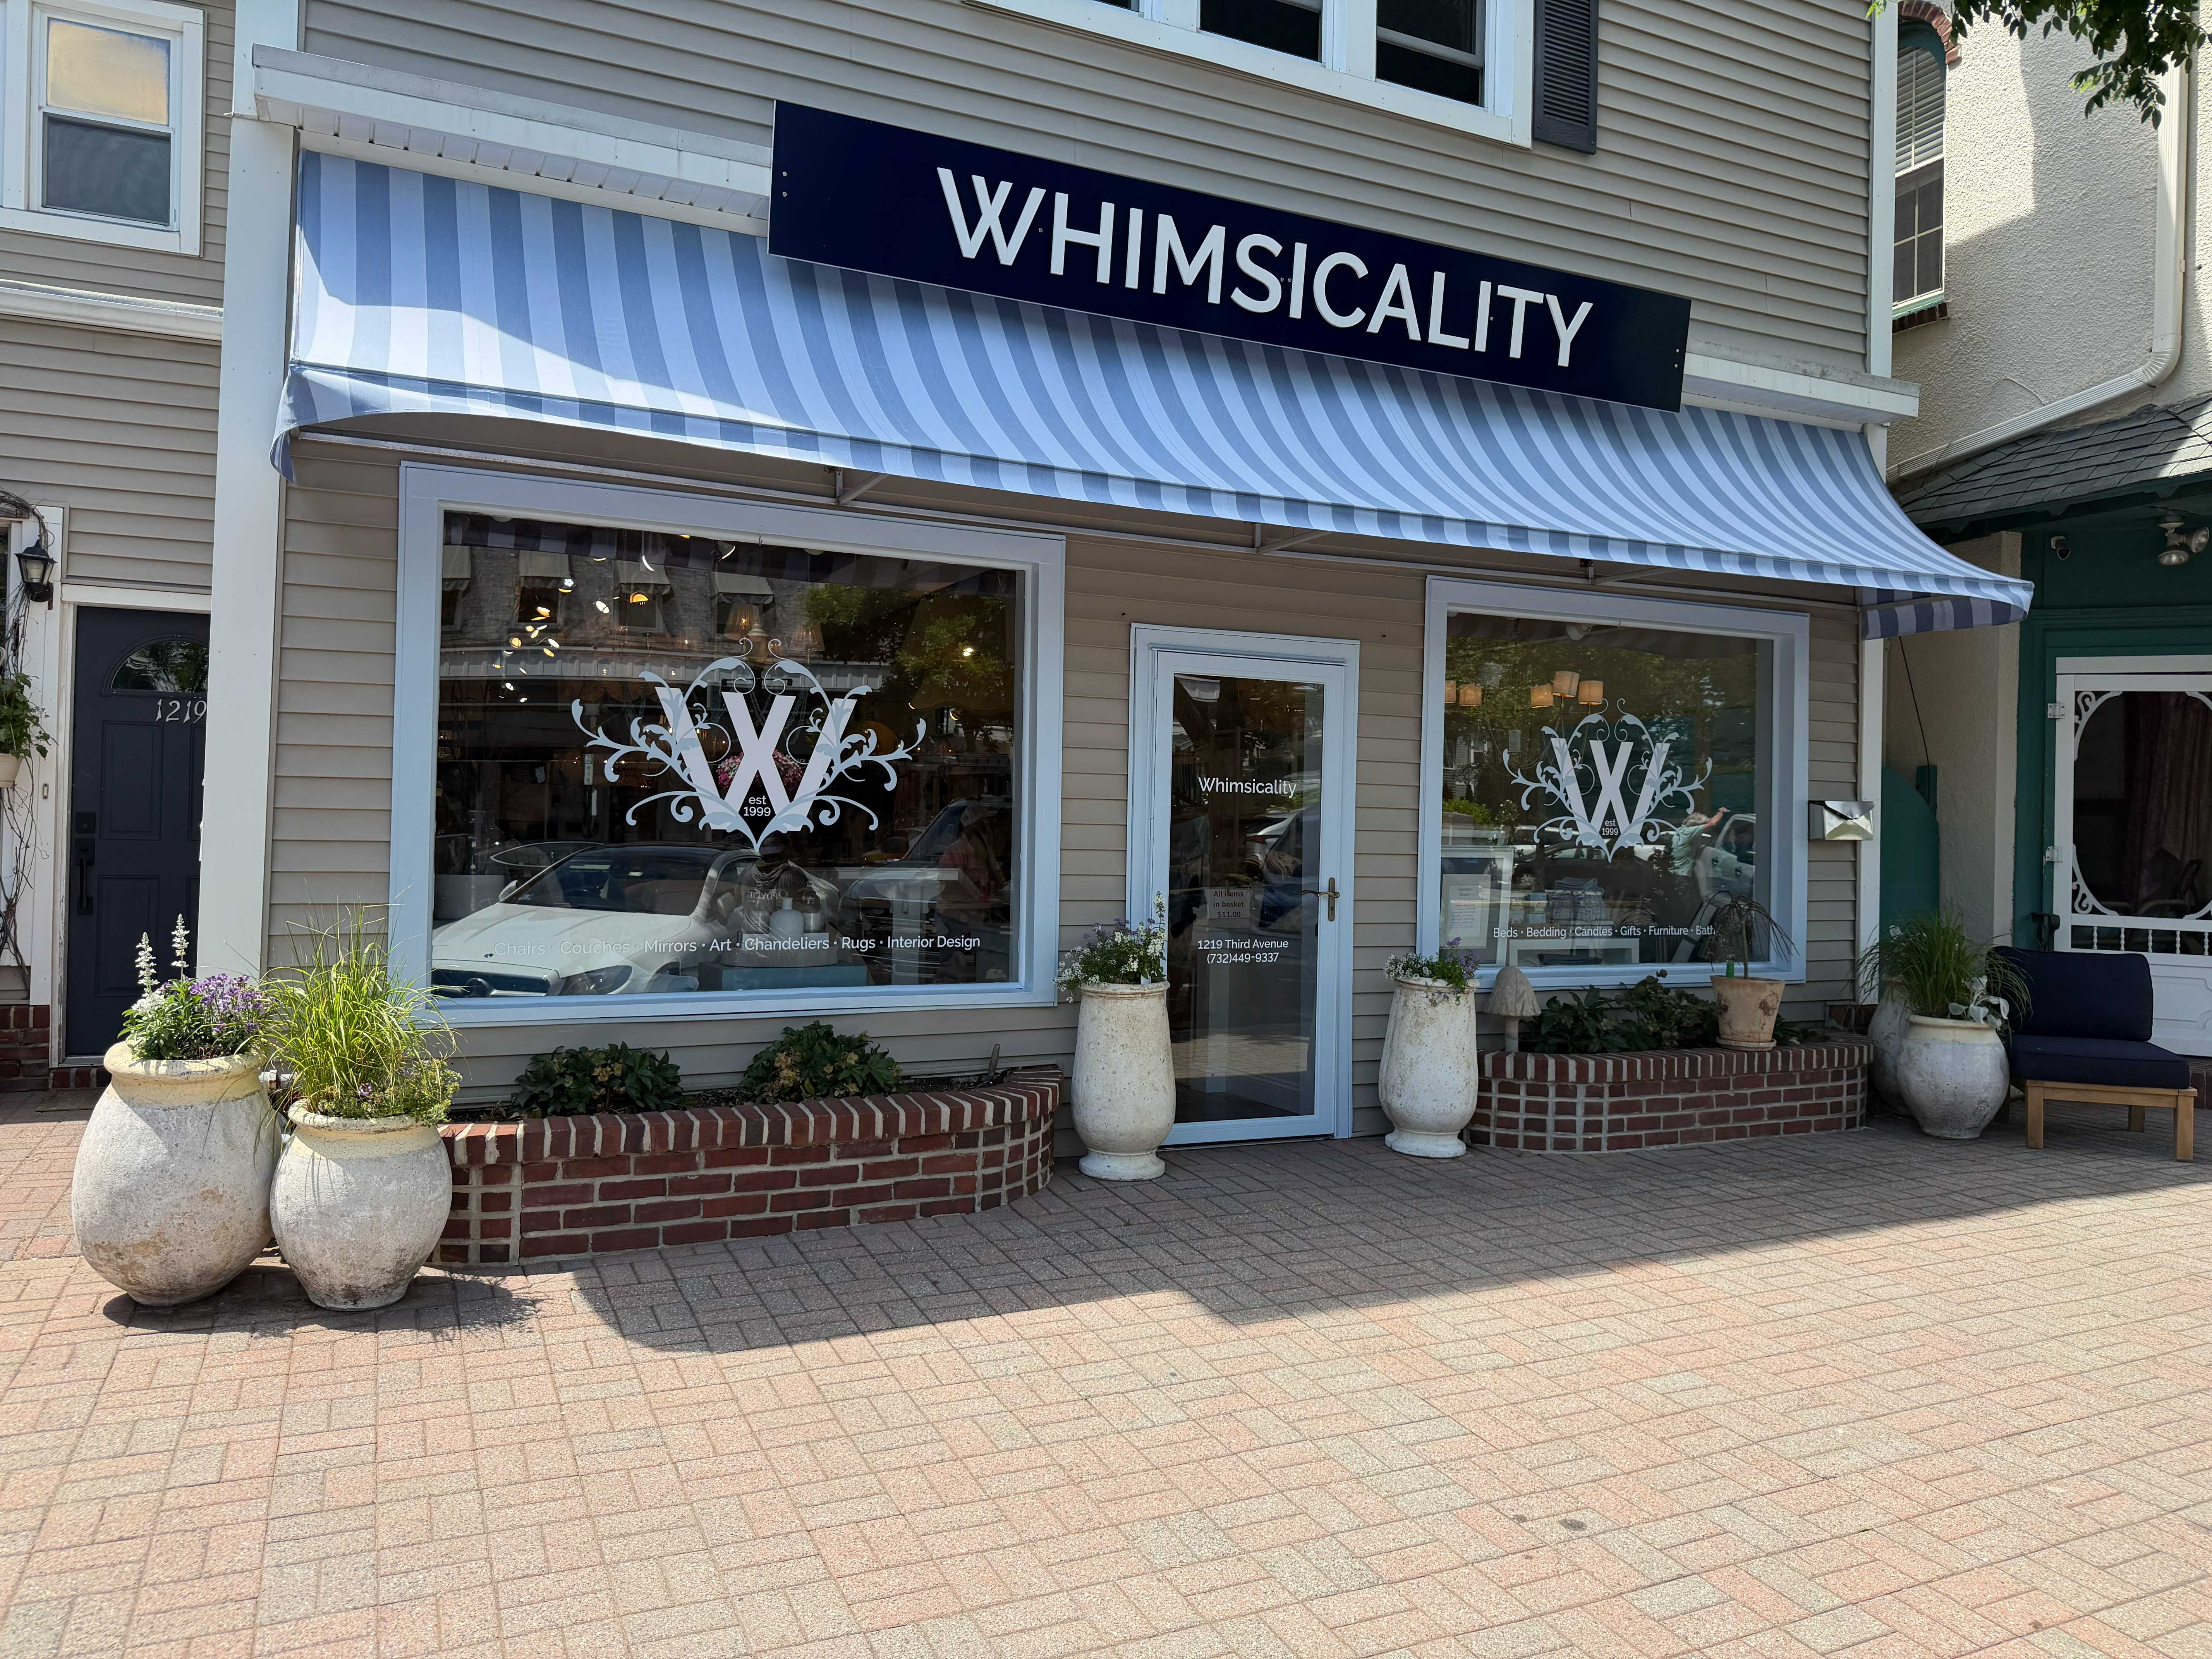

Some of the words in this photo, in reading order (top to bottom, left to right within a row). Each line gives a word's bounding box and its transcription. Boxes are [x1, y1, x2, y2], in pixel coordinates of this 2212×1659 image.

[936, 167, 1593, 368] WHIMSICALITY
[155, 699, 207, 723] 1219
[1198, 777, 1297, 798] Whimsicality
[749, 795, 767, 805] est
[744, 806, 771, 816] 1999
[1602, 828, 1618, 836] 1999
[1493, 927, 1518, 938] Beds
[1526, 927, 1566, 939] Bedding
[1574, 926, 1613, 936] Candles
[1620, 926, 1641, 936] Gifts
[1649, 925, 1688, 936] Furniture
[494, 942, 545, 955] Chairs
[560, 941, 630, 953] Couches
[644, 939, 697, 952] Mirrors
[709, 938, 732, 951] Art
[744, 936, 830, 950] Chandeliers
[842, 936, 876, 952] Rugs
[887, 935, 934, 948] Interior
[937, 935, 980, 950] Design
[1197, 940, 1223, 950] 1219
[1225, 939, 1250, 949] Third
[1252, 939, 1289, 948] Avenue
[1207, 952, 1279, 964] (732)449-9337
